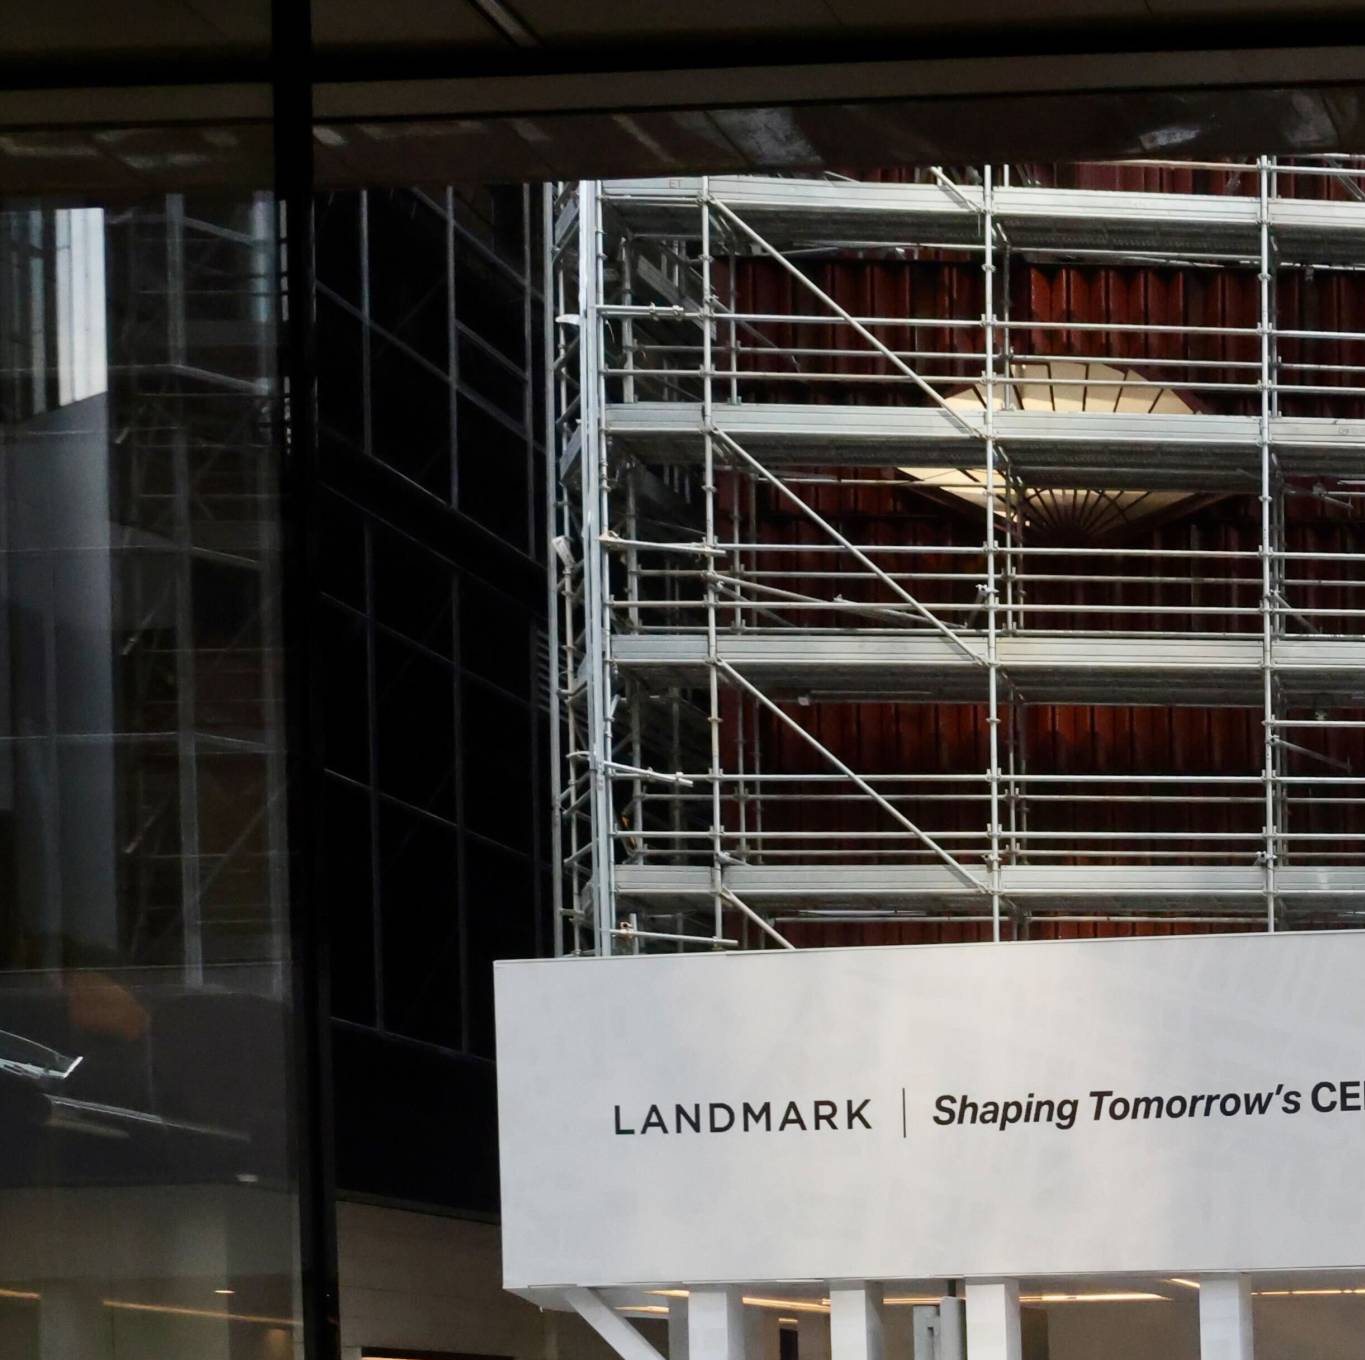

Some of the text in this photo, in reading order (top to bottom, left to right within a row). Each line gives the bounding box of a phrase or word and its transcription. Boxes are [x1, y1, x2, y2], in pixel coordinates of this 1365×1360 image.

[614, 1098, 873, 1135] LANDMARK
[932, 1092, 1079, 1130] Shaping
[1089, 1083, 1301, 1121] Tomorrow's
